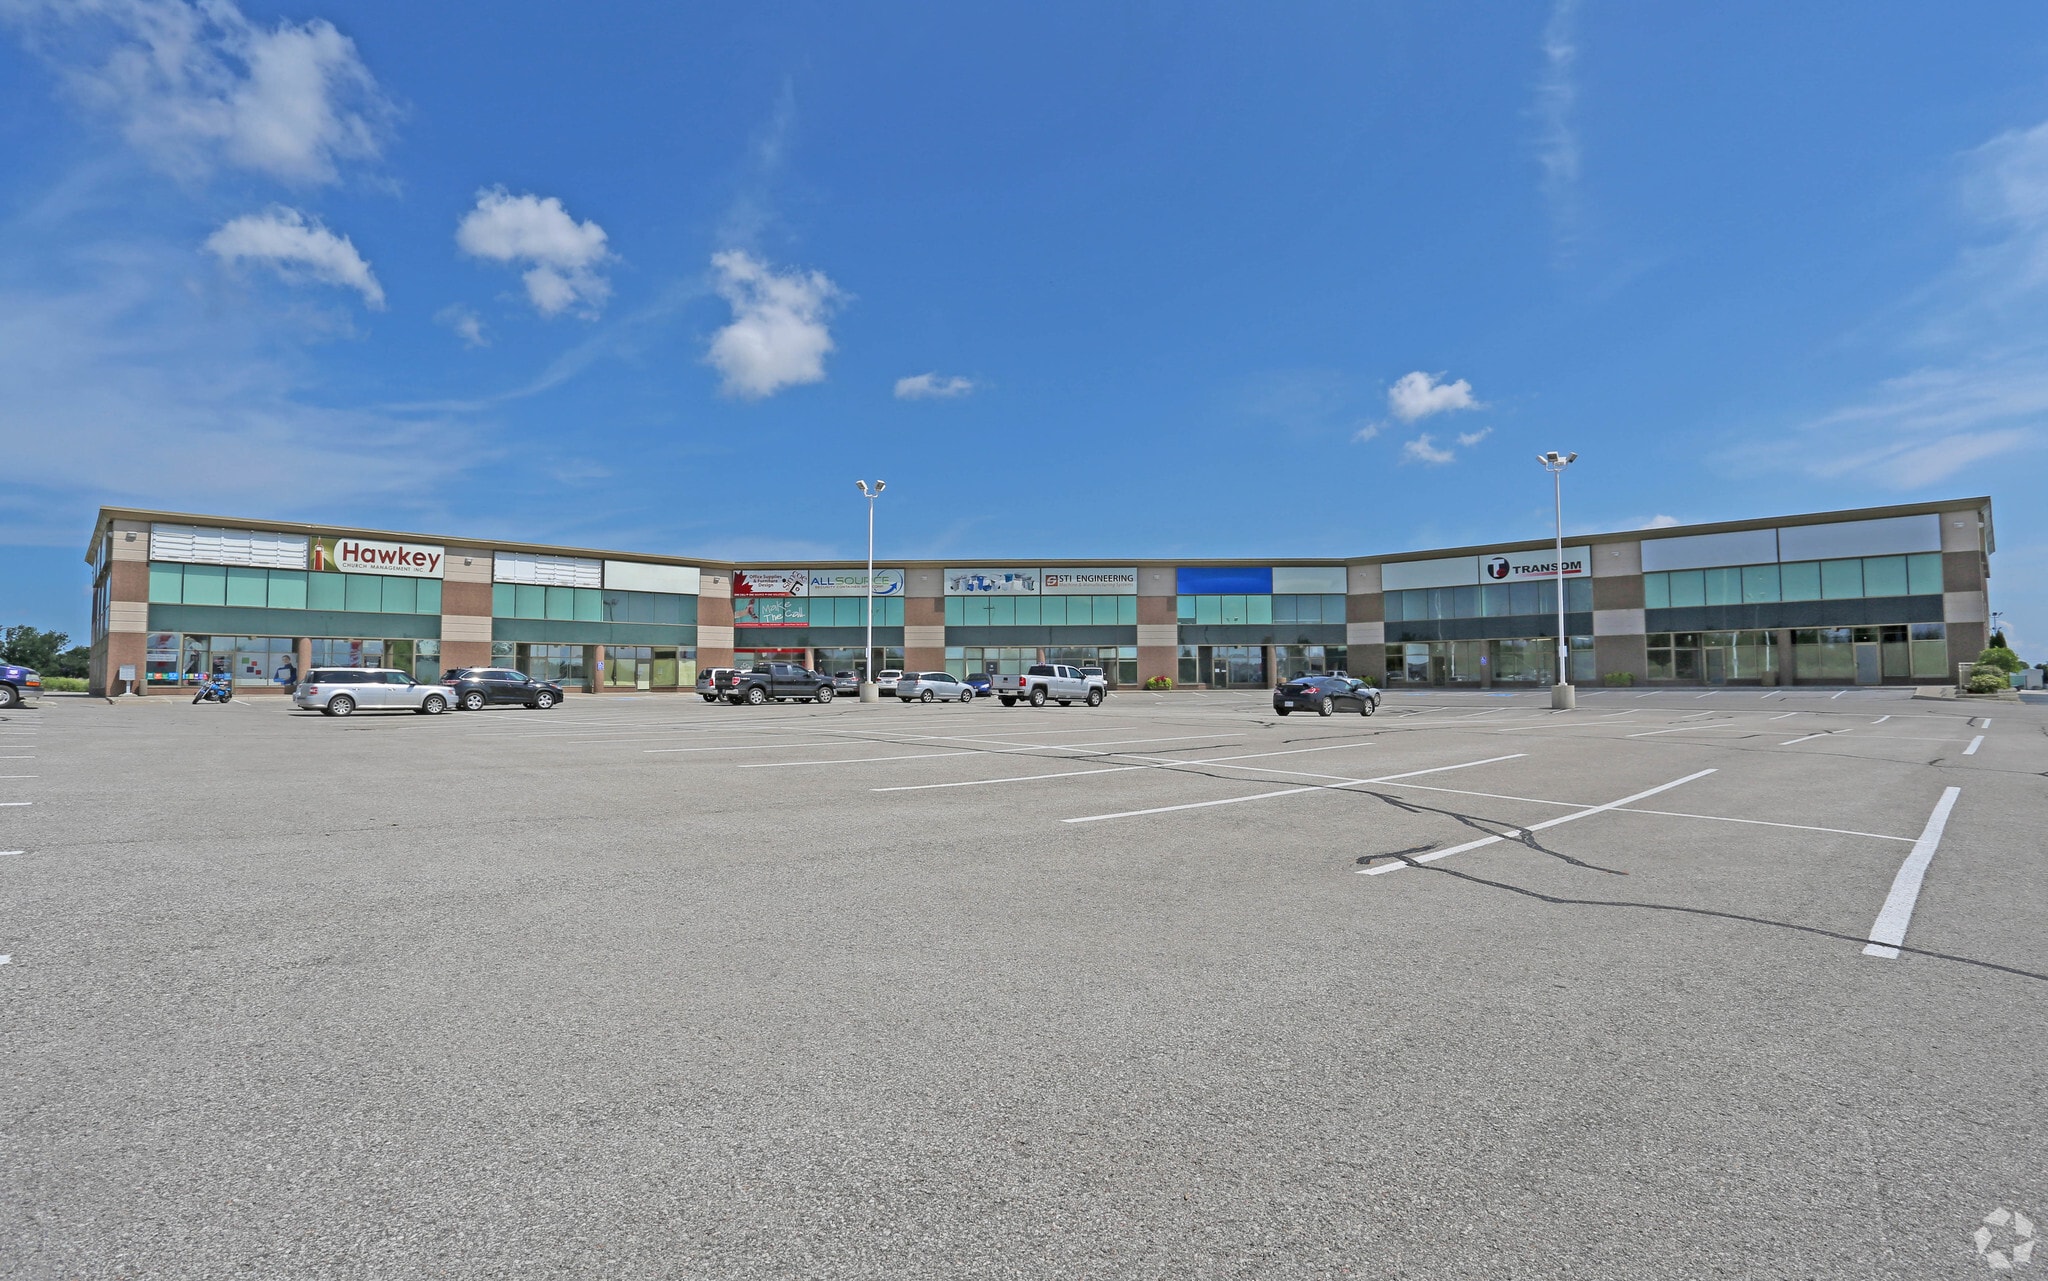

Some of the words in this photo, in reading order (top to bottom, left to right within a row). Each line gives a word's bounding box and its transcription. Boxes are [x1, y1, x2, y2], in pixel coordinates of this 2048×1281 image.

[342, 541, 441, 573] Hawkey
[370, 564, 411, 572] MANAGEMENT
[1512, 560, 1582, 574] TRANSOM
[1059, 574, 1072, 582] STI
[1076, 574, 1134, 582] ENGINEERING
[762, 600, 792, 614] Make
[763, 613, 783, 623] The
